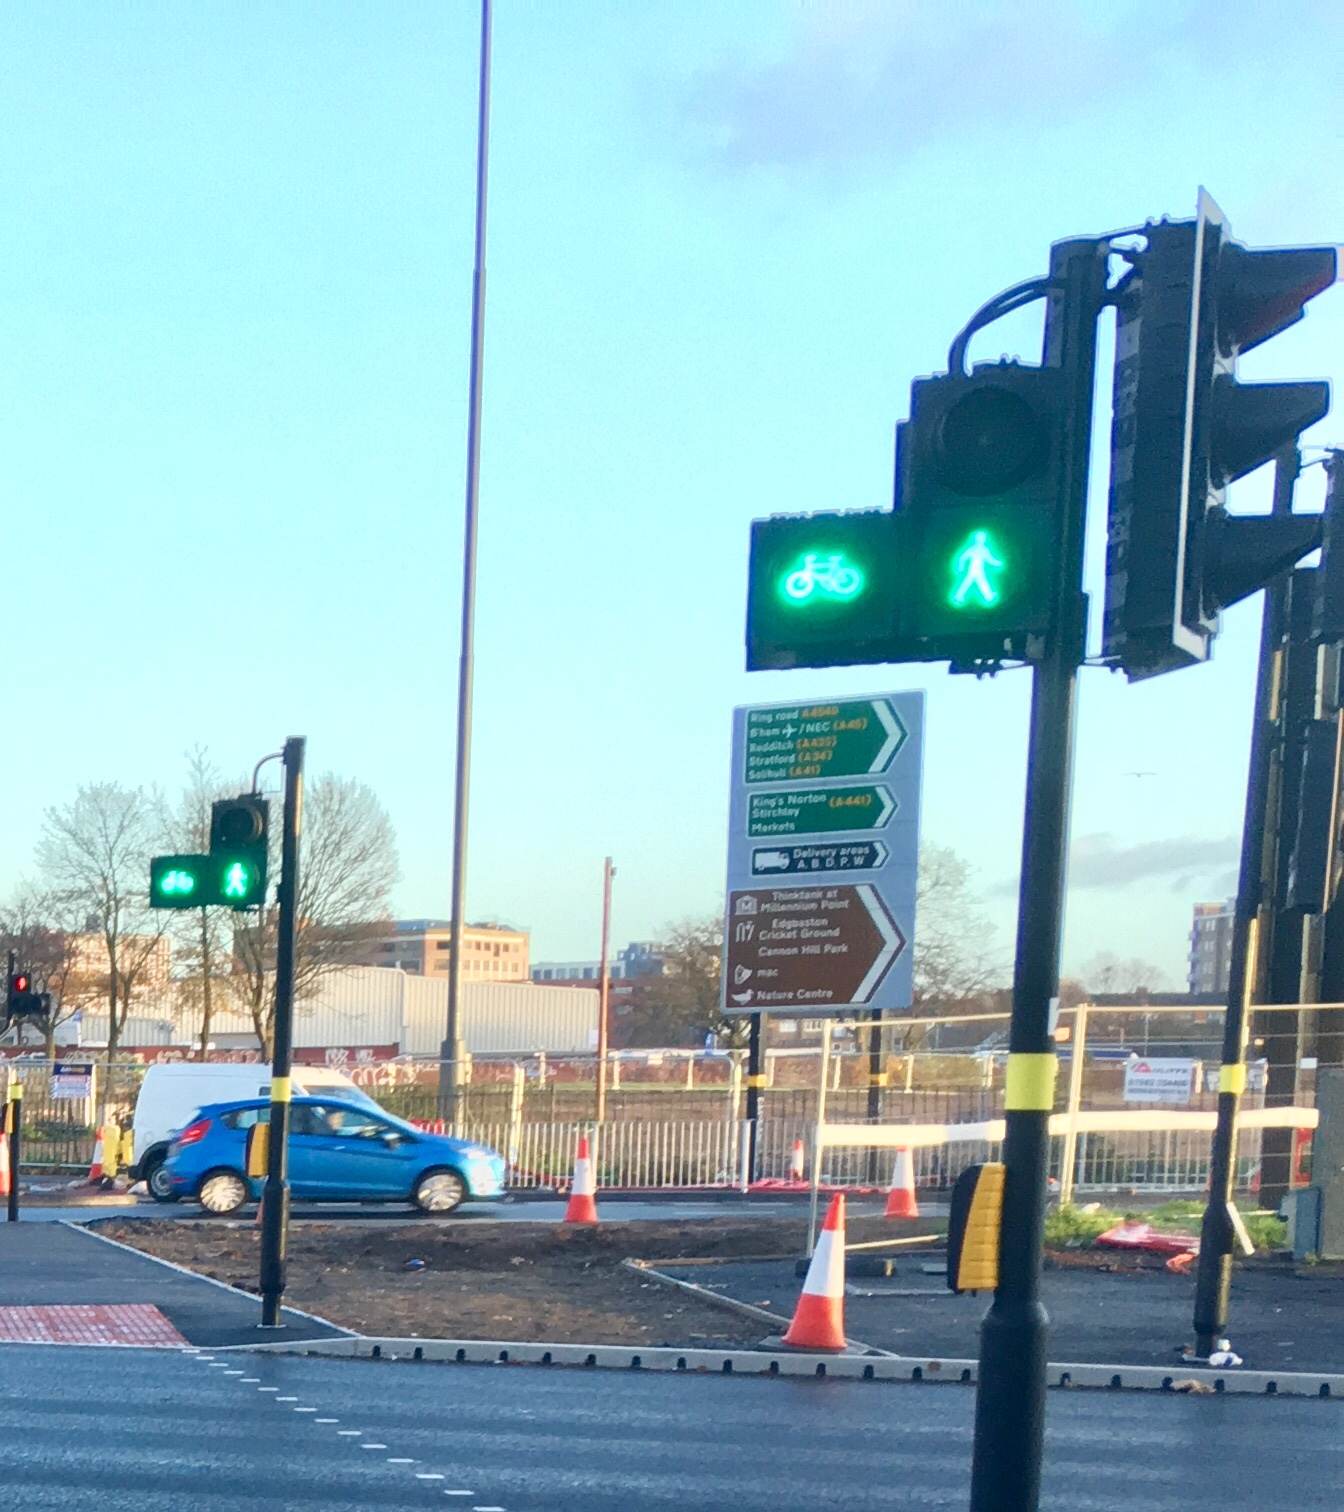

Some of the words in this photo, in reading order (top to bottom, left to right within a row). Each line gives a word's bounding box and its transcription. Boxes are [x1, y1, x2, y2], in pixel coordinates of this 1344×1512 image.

[750, 713, 773, 723] Ring
[776, 710, 799, 721] road
[749, 740, 794, 753] Redditch
[749, 753, 795, 767] Stratford
[798, 749, 833, 763] (A34)
[749, 767, 786, 780] Solihull
[752, 797, 784, 808] King's
[788, 793, 826, 805] Norton
[752, 807, 800, 819] Stirchley
[752, 821, 795, 833] Markets
[793, 848, 837, 860] Delivery
[840, 846, 869, 856] areas
[853, 856, 864, 866] W
[772, 891, 823, 901] Thinktank
[826, 889, 838, 899] at
[760, 902, 818, 912] Millennium
[821, 899, 849, 910] Point
[772, 919, 828, 930] Edgbaston
[759, 930, 797, 941] Cricket
[800, 927, 840, 939] Ground
[758, 946, 798, 957] Cannon
[801, 944, 821, 955] Hill
[824, 943, 849, 954] Park
[757, 968, 779, 978] mac
[756, 990, 794, 1001] Nature
[797, 988, 834, 999] Centre
